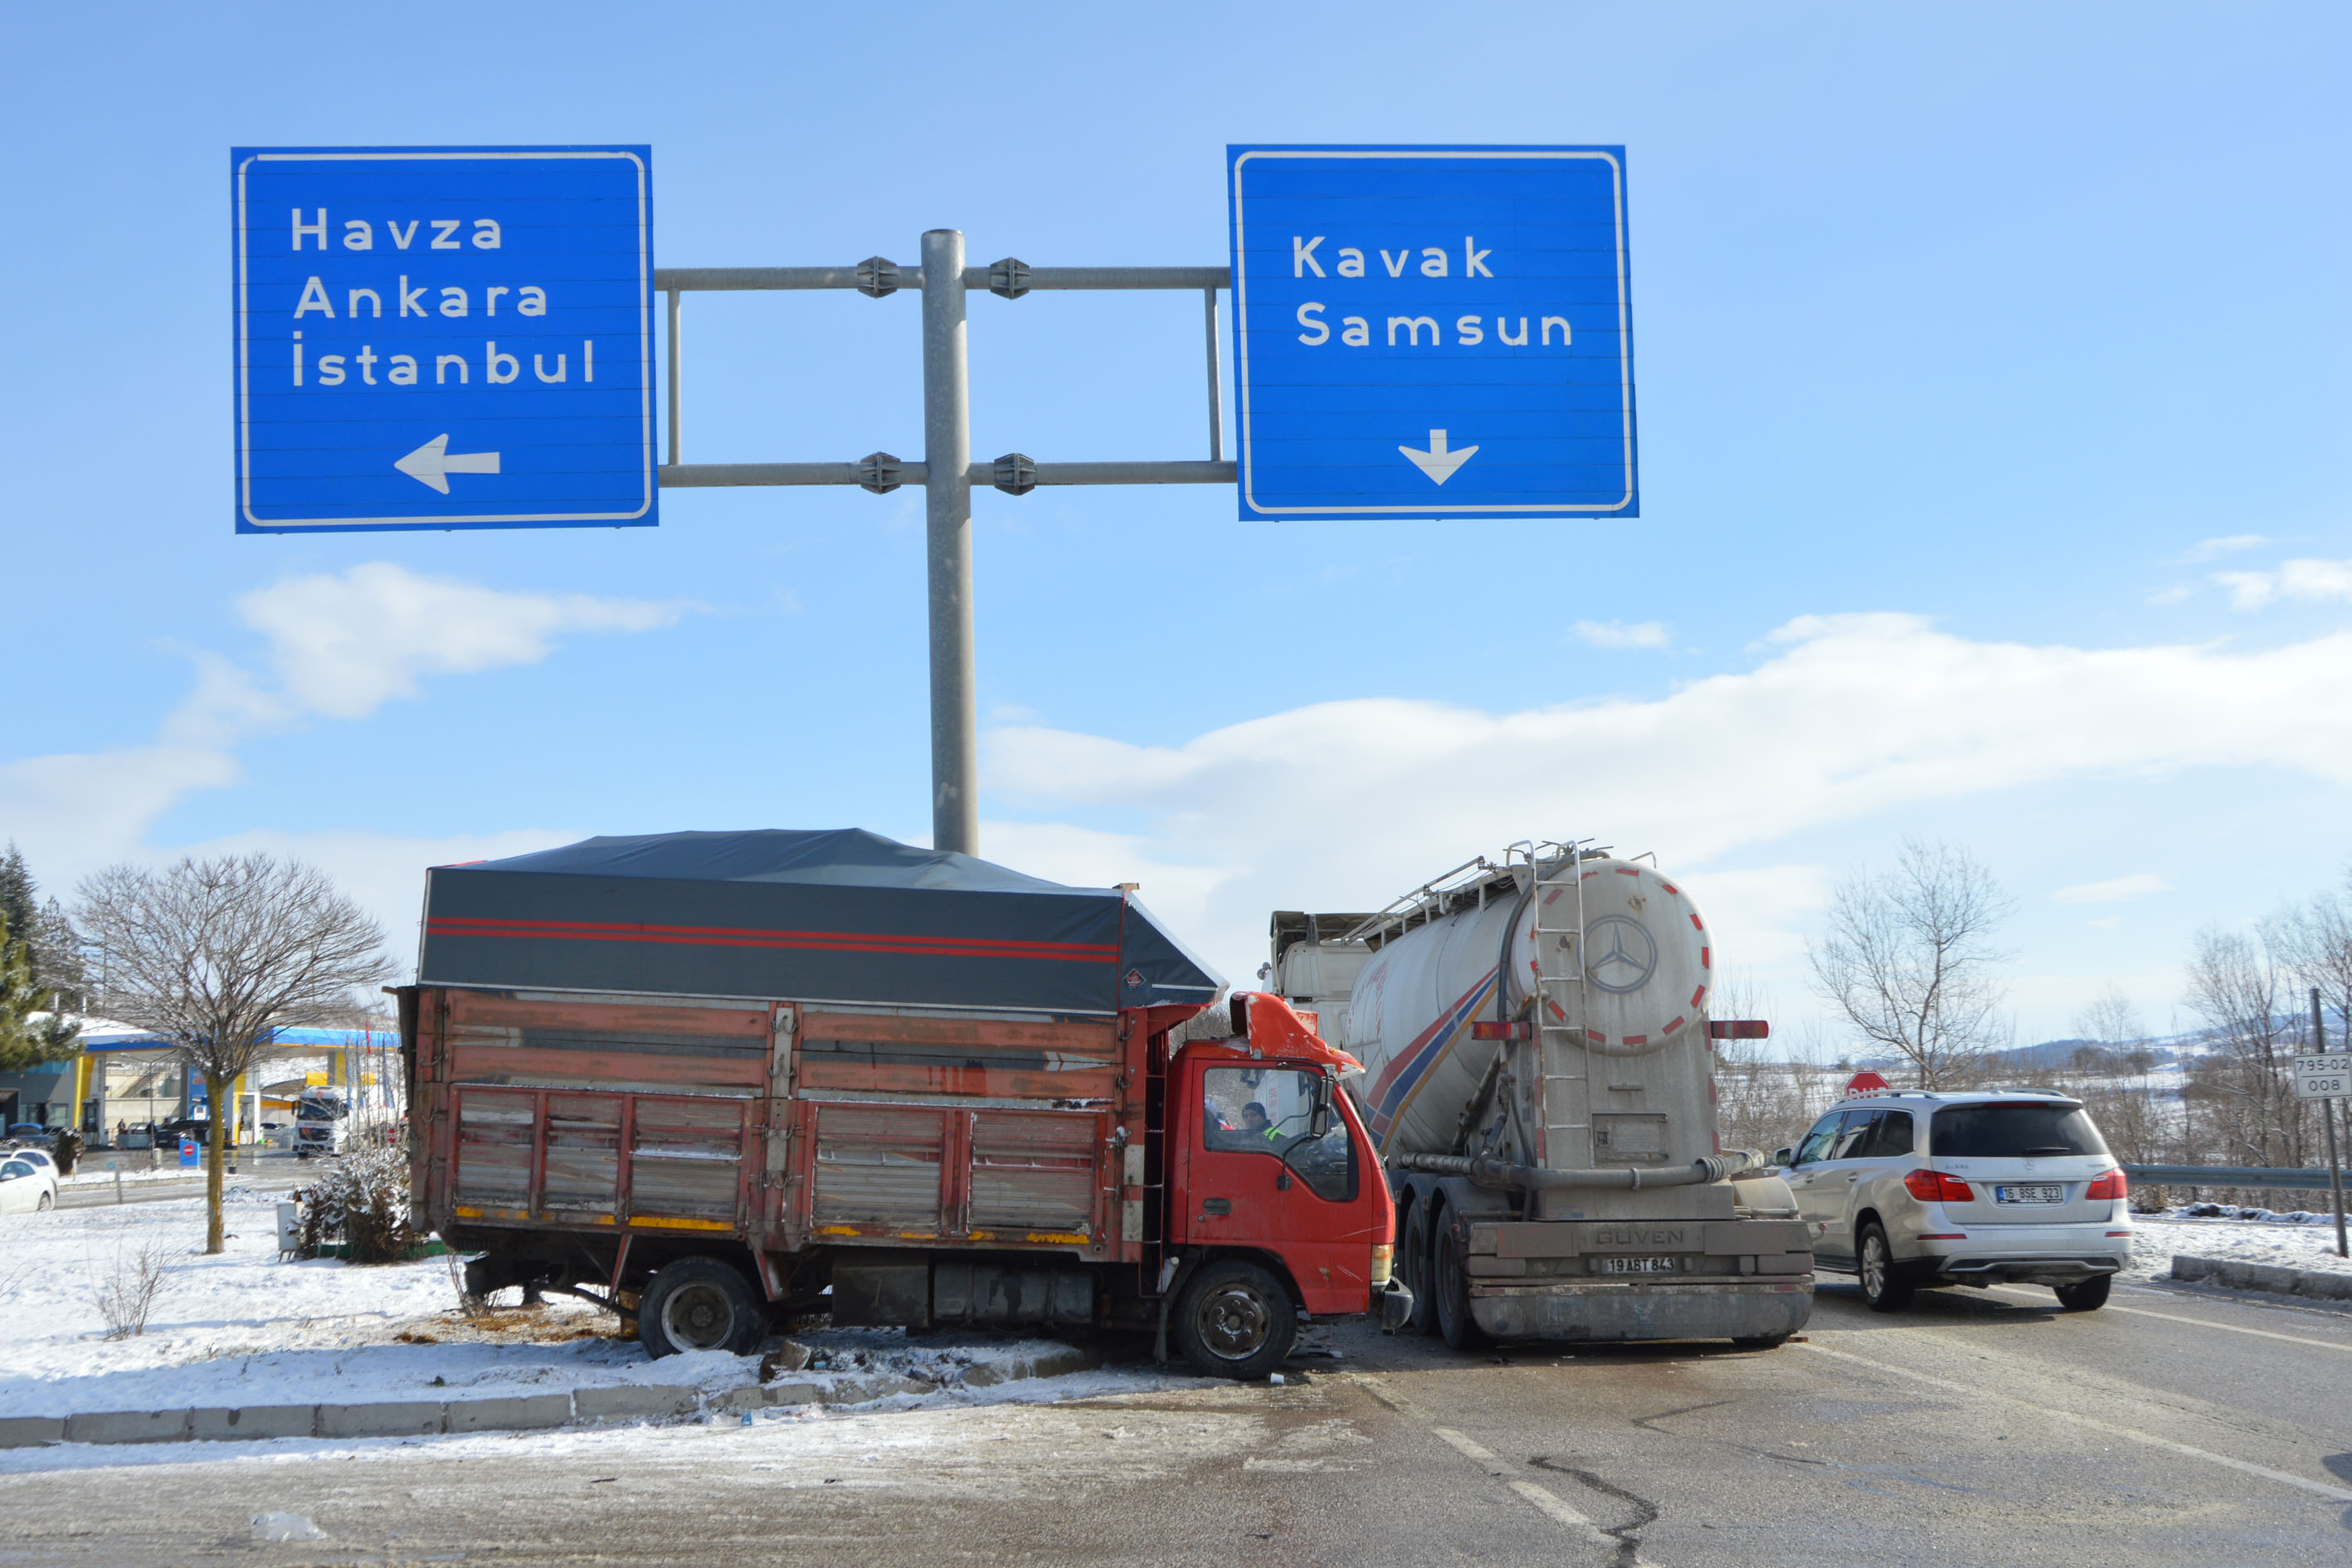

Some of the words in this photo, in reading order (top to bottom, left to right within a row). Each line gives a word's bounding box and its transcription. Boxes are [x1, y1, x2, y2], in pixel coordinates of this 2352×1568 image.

[291, 207, 501, 251] Havza
[1293, 236, 1494, 278] Kavak
[293, 275, 547, 319] Ankara
[1296, 302, 1572, 347] Samsun
[293, 330, 593, 387] İstanbul
[2296, 1059, 2349, 1072] 795-02
[2309, 1079, 2340, 1092] 008
[2004, 1187, 2014, 1200] 16
[2018, 1187, 2038, 1199] BSE
[2041, 1187, 2060, 1199] 923
[1609, 1259, 1624, 1272] 19
[1626, 1259, 1649, 1272] ABT
[1650, 1258, 1675, 1271] 843
